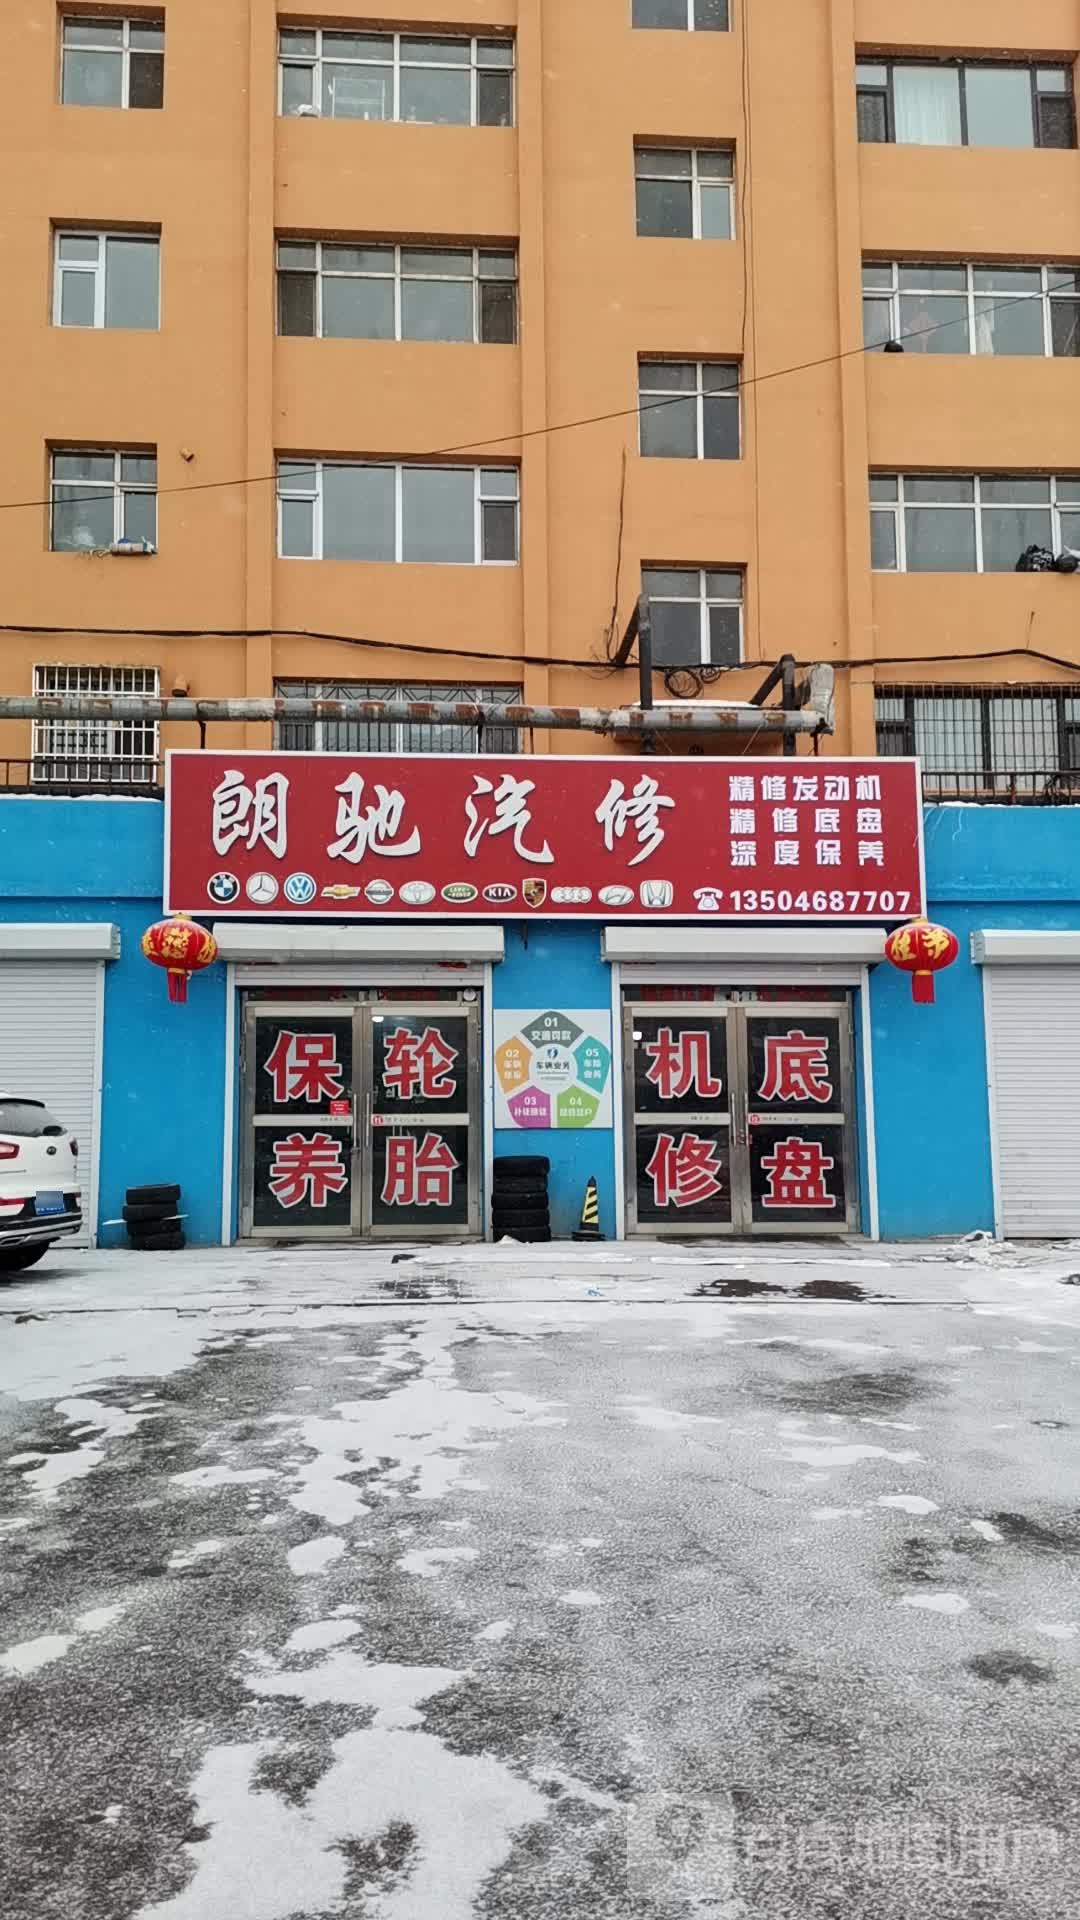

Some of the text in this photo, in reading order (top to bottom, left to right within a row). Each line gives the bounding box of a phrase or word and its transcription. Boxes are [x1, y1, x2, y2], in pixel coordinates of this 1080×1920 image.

[728, 775, 882, 801] 精修发动机
[212, 769, 676, 867] 朗驰汽修
[728, 808, 883, 834] 精修底盘
[730, 839, 885, 867] 深度保养
[487, 888, 512, 897] KIA
[729, 889, 911, 913] 13504687707
[544, 1017, 558, 1027] 01
[505, 1049, 520, 1057] 02
[585, 1048, 599, 1057] 05
[524, 1097, 537, 1105] 03
[569, 1097, 582, 1105] 04
[263, 1029, 348, 1208] 保养
[381, 1026, 461, 1206] 轮胎
[645, 1027, 722, 1208] 机修
[757, 1030, 836, 1208] 底盘
